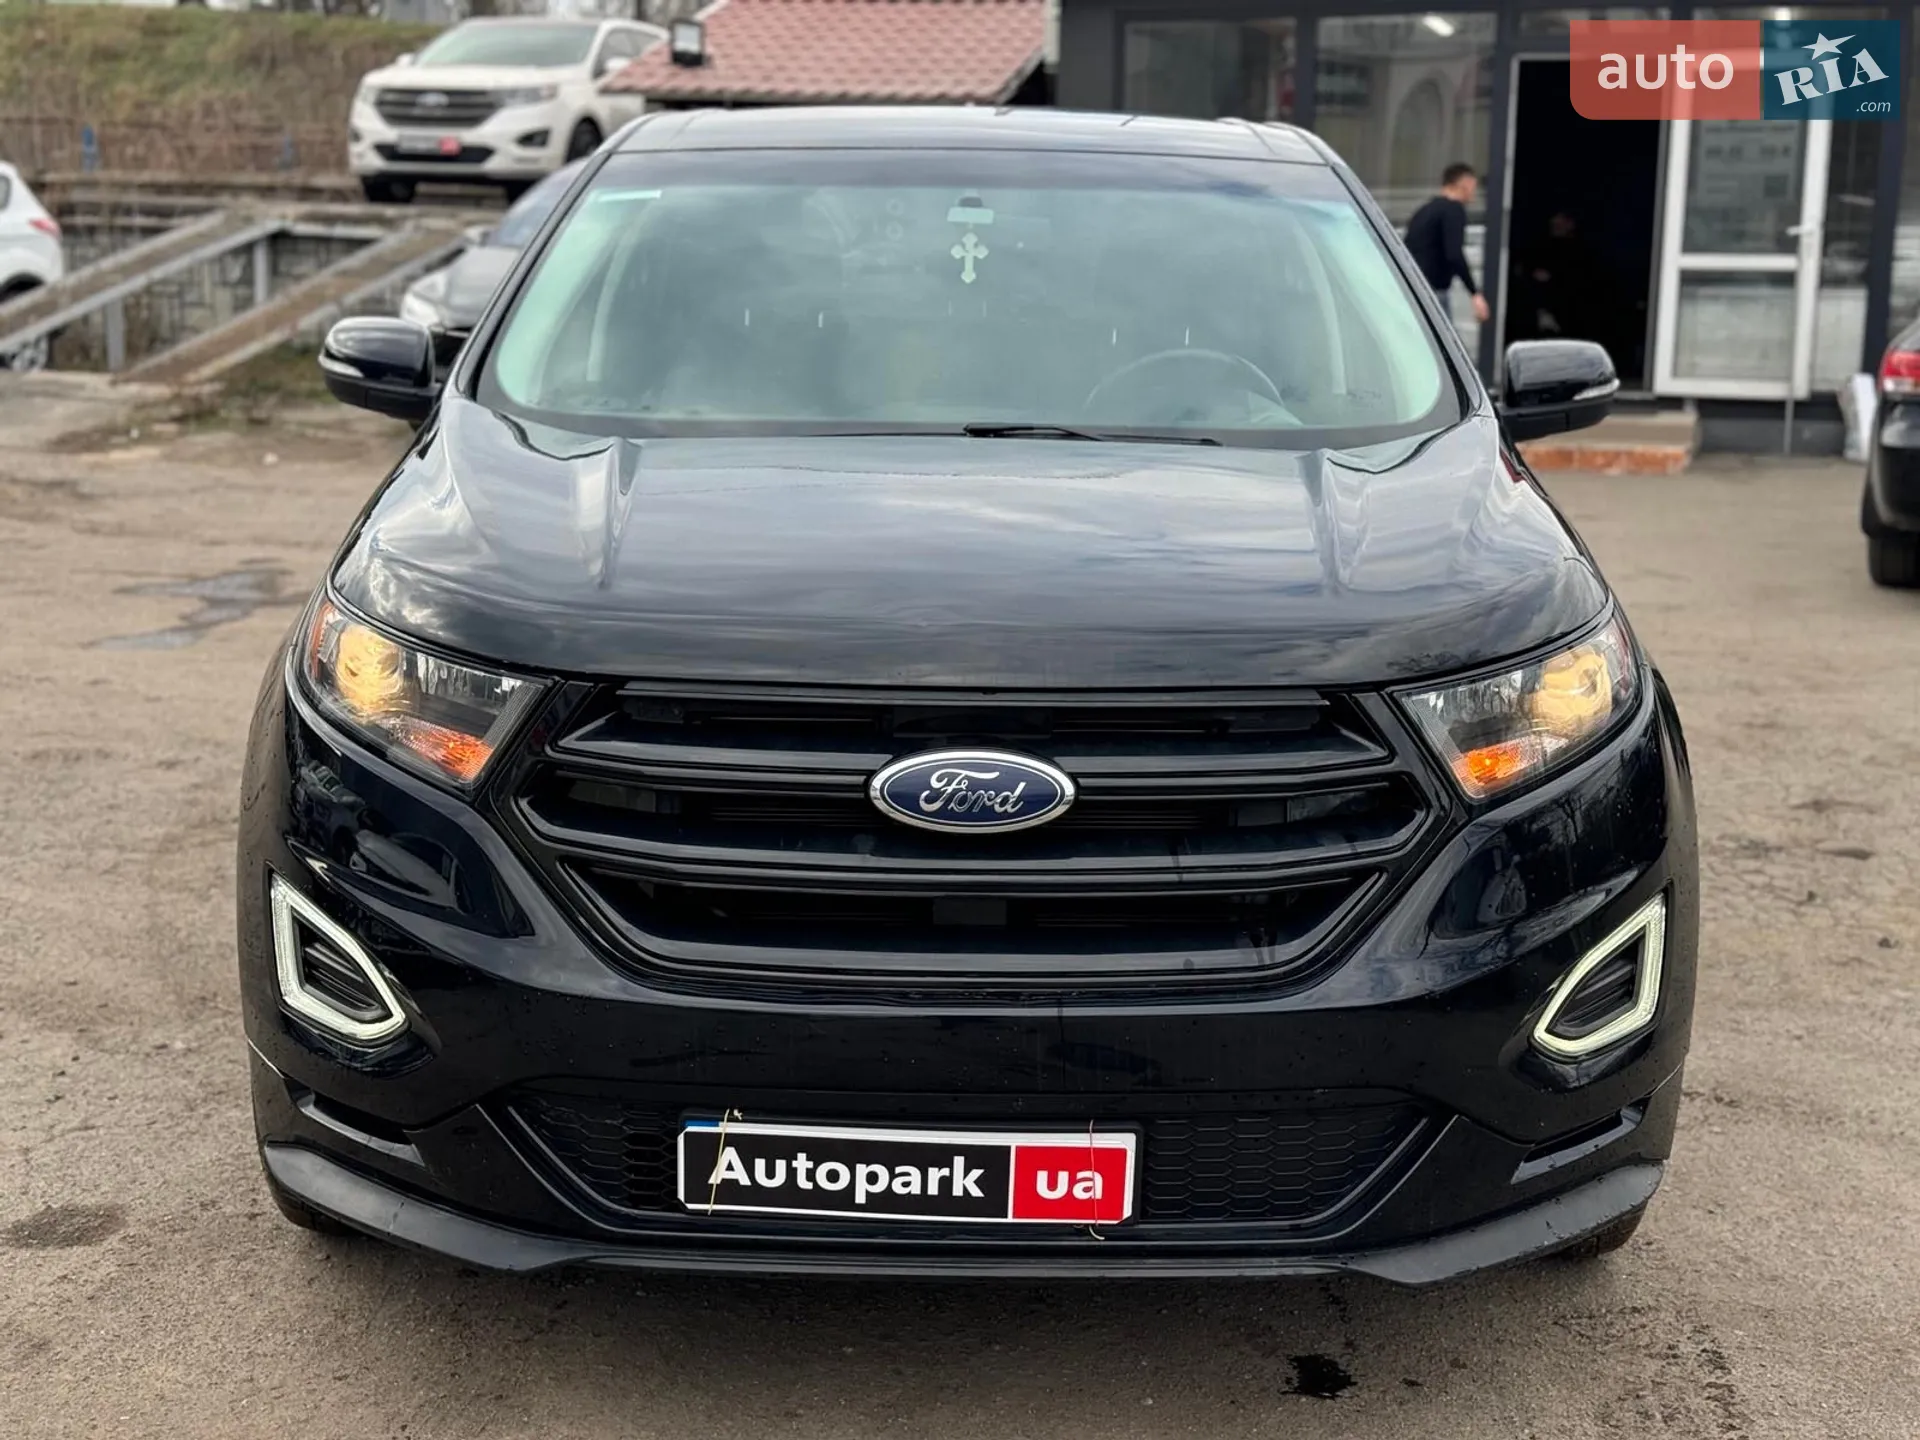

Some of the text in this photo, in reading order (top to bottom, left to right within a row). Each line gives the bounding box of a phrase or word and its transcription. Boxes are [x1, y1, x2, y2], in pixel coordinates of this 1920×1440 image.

[919, 768, 1027, 814] Ford
[708, 1146, 1103, 1204] Autopark ua
